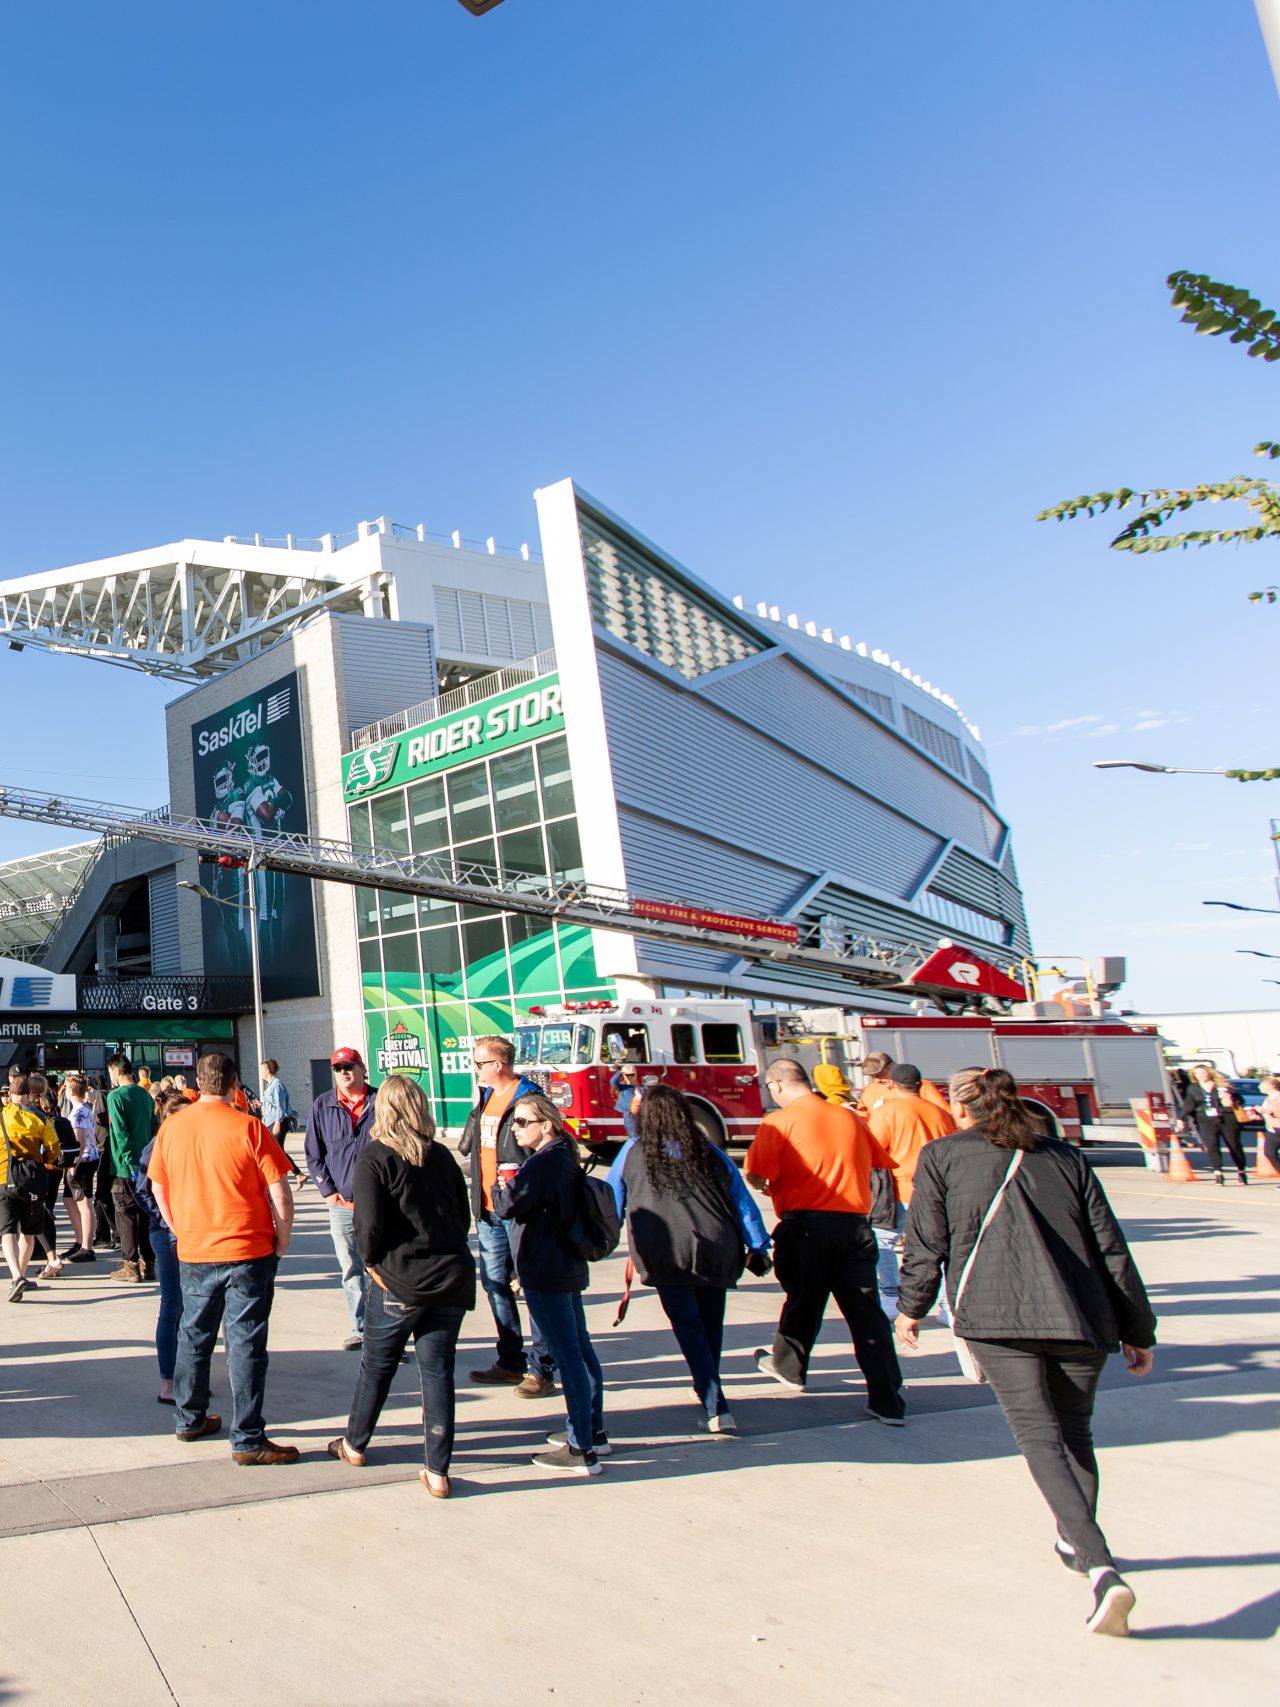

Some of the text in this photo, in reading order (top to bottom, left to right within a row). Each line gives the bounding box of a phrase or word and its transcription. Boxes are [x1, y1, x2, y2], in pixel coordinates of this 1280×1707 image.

[198, 703, 262, 756] SaskTel
[408, 684, 564, 767] RIDER STOR
[635, 902, 798, 938] REGINA FIRE & PROTECTIVE SERVICES
[143, 995, 198, 1011] Gate 3
[403, 1037, 419, 1050] CUP
[377, 1048, 430, 1070] FESTIVAL
